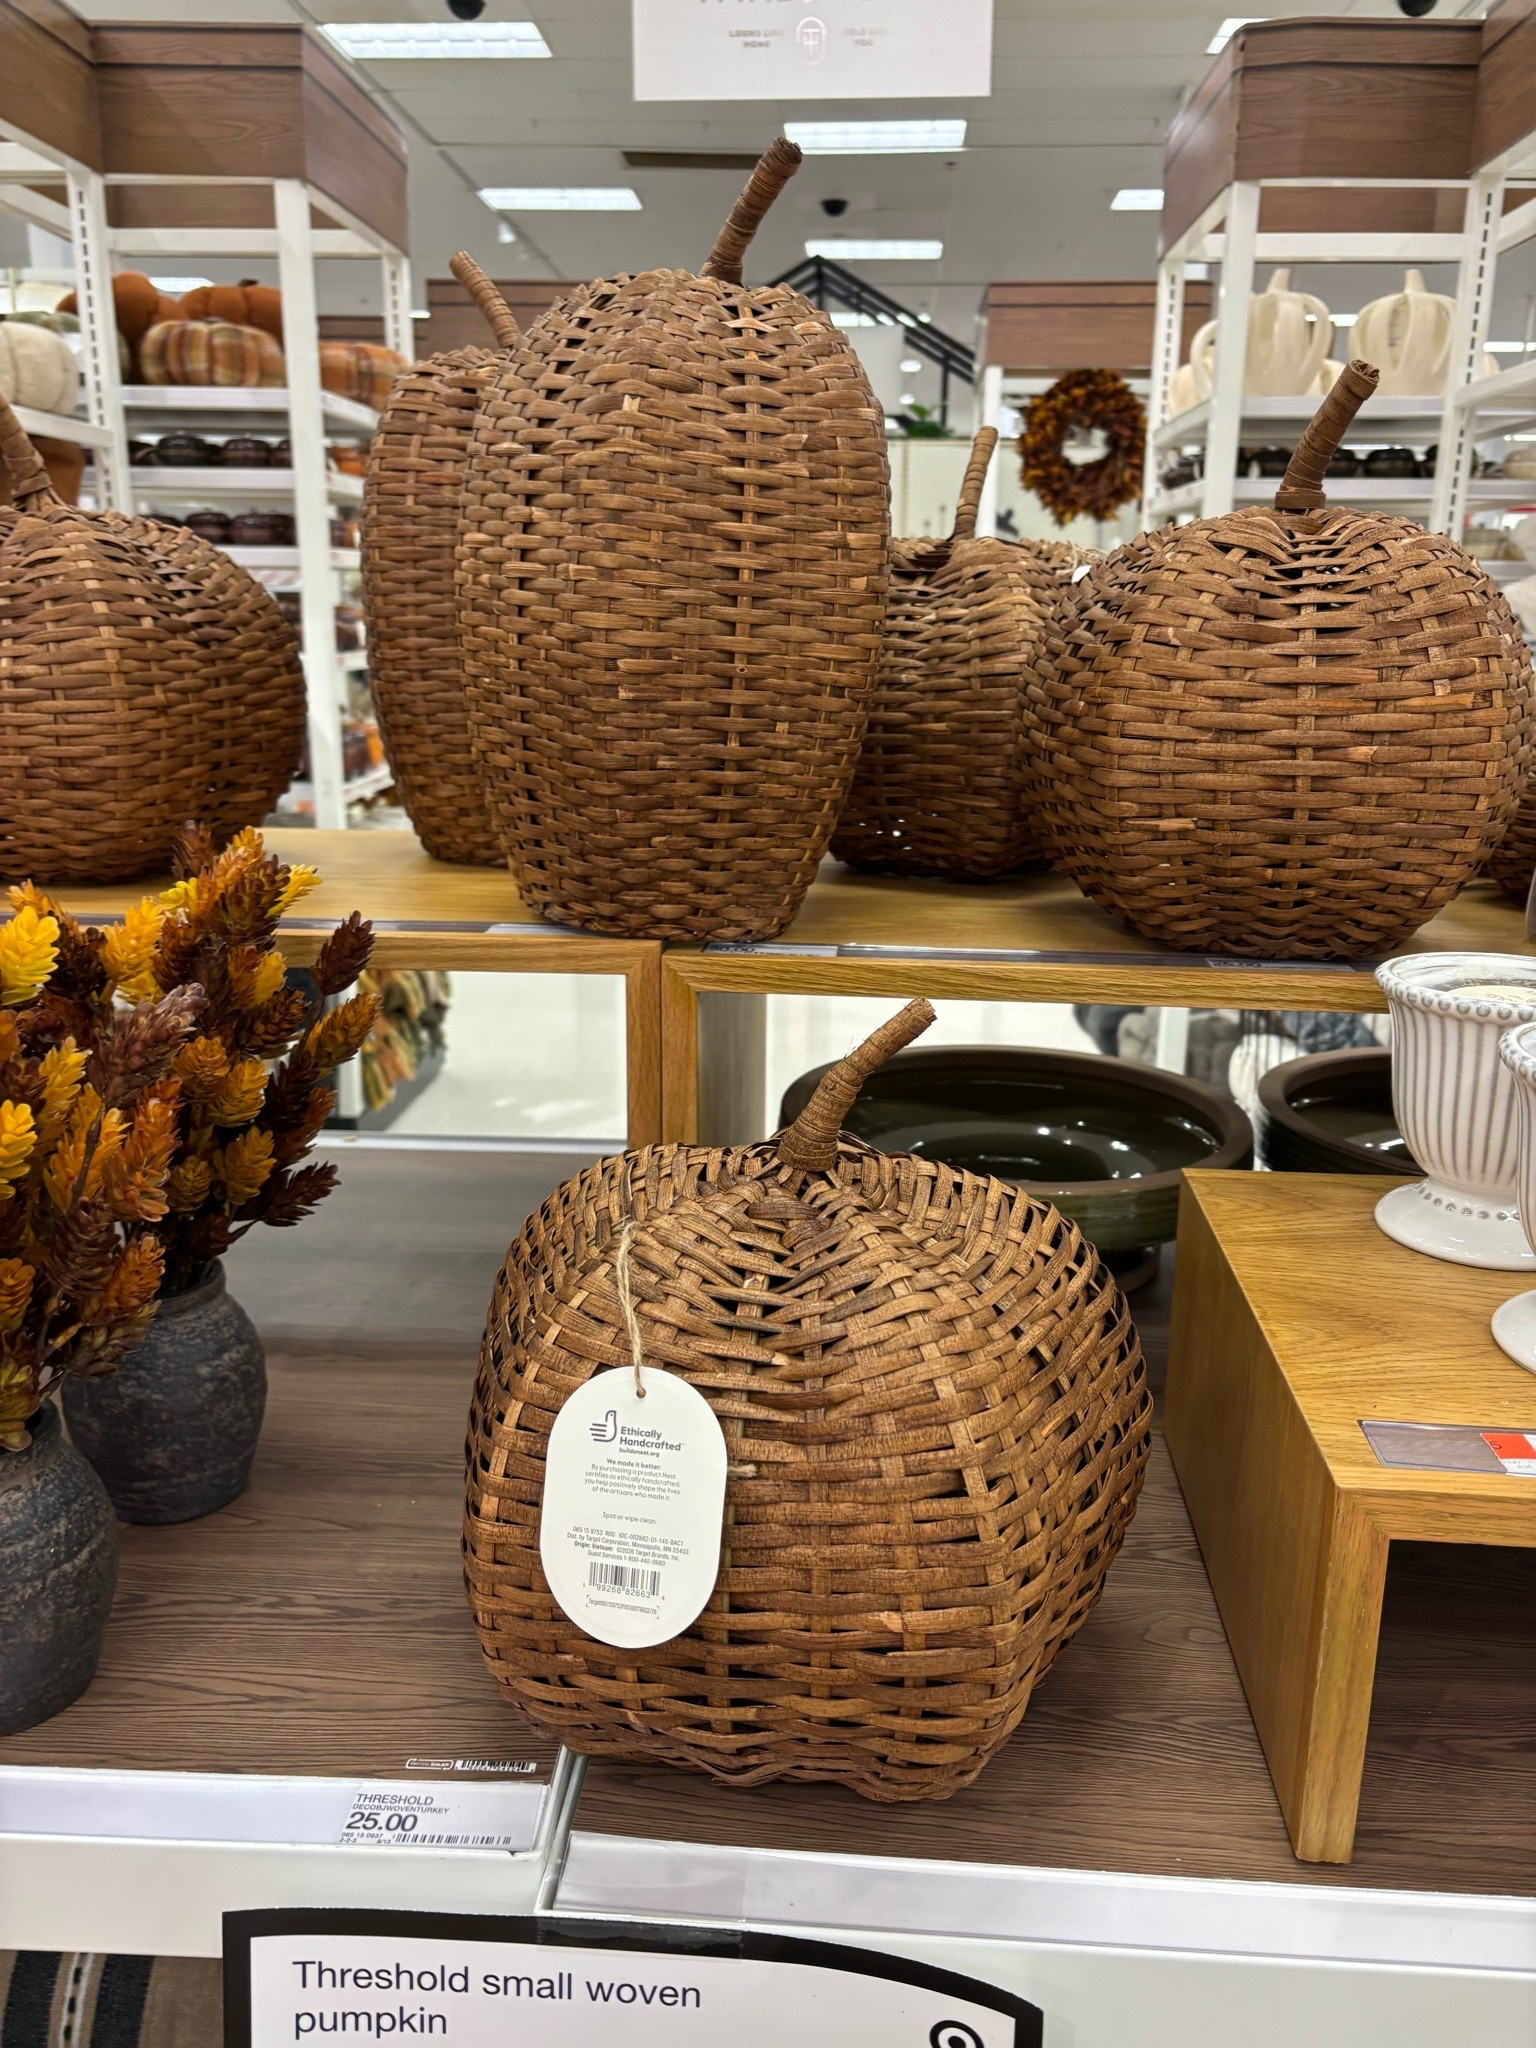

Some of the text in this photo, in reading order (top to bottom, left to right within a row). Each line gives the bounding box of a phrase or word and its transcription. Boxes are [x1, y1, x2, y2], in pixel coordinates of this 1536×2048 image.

[620, 1426, 662, 1440] Ethically
[619, 1436, 682, 1451] Handcrafted
[619, 1448, 660, 1458] buildanest.org
[617, 1459, 634, 1467] made
[640, 1462, 662, 1470] better.
[585, 1471, 608, 1479] certifies
[617, 1474, 642, 1484] ethically
[600, 1465, 632, 1476] purchasing
[637, 1470, 661, 1478] product
[662, 1472, 676, 1480] Nest
[596, 1478, 609, 1486] help
[609, 1480, 636, 1490] positively
[637, 1484, 656, 1493] shape
[657, 1486, 667, 1494] the
[668, 1487, 681, 1495] lives
[610, 1488, 634, 1497] artisans
[648, 1492, 664, 1500] made
[602, 1512, 616, 1520] Spot
[624, 1514, 638, 1523] wipe
[640, 1516, 657, 1524] clean.
[586, 1535, 602, 1544] Target
[574, 1540, 590, 1549] Origin:
[592, 1542, 613, 1552] Vietnam
[636, 1548, 651, 1558] Target
[602, 1552, 622, 1560] Services
[596, 1584, 622, 1594] 99268
[625, 1588, 651, 1599] 82663
[356, 1793, 434, 1806] THRESHOLD
[352, 1803, 450, 1814] DECOBJWOVENTURKEY
[345, 1811, 418, 1832] 25.00
[292, 1960, 702, 2008] Threshold small woven
[294, 2006, 448, 2041] pumpkin
